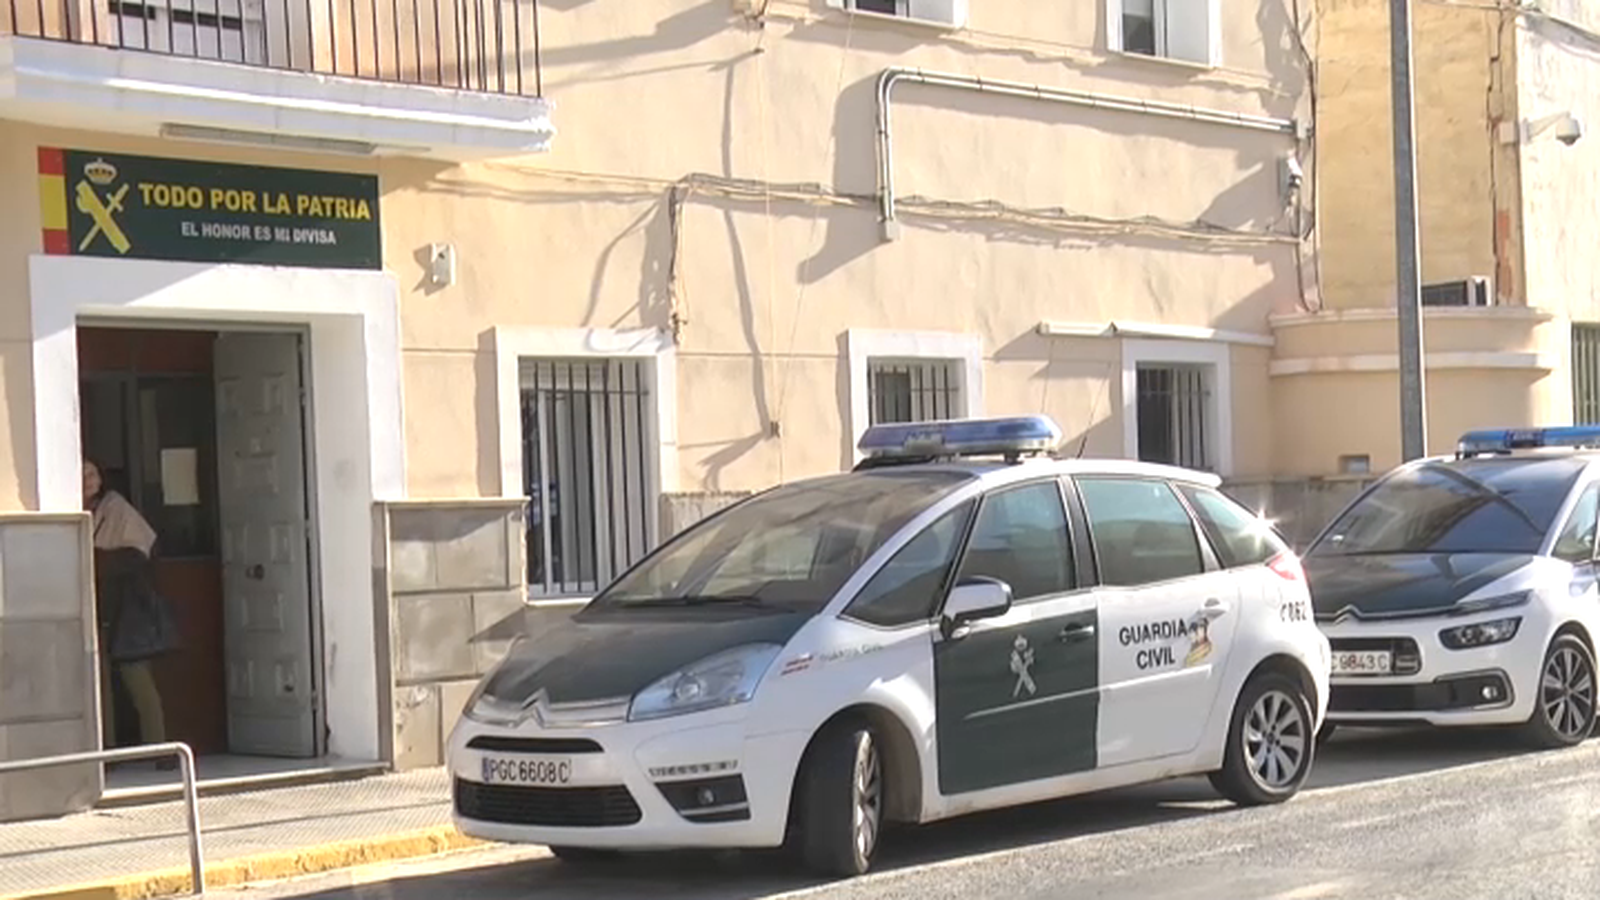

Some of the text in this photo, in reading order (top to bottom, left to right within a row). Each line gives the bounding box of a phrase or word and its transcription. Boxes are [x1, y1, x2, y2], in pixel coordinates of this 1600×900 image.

[138, 183, 371, 220] TODO POR LA PATRIA
[181, 221, 337, 245] EL HONOR ES MI DIVISA
[1119, 618, 1188, 646] GUARDIA
[1136, 646, 1176, 670] CIVIL
